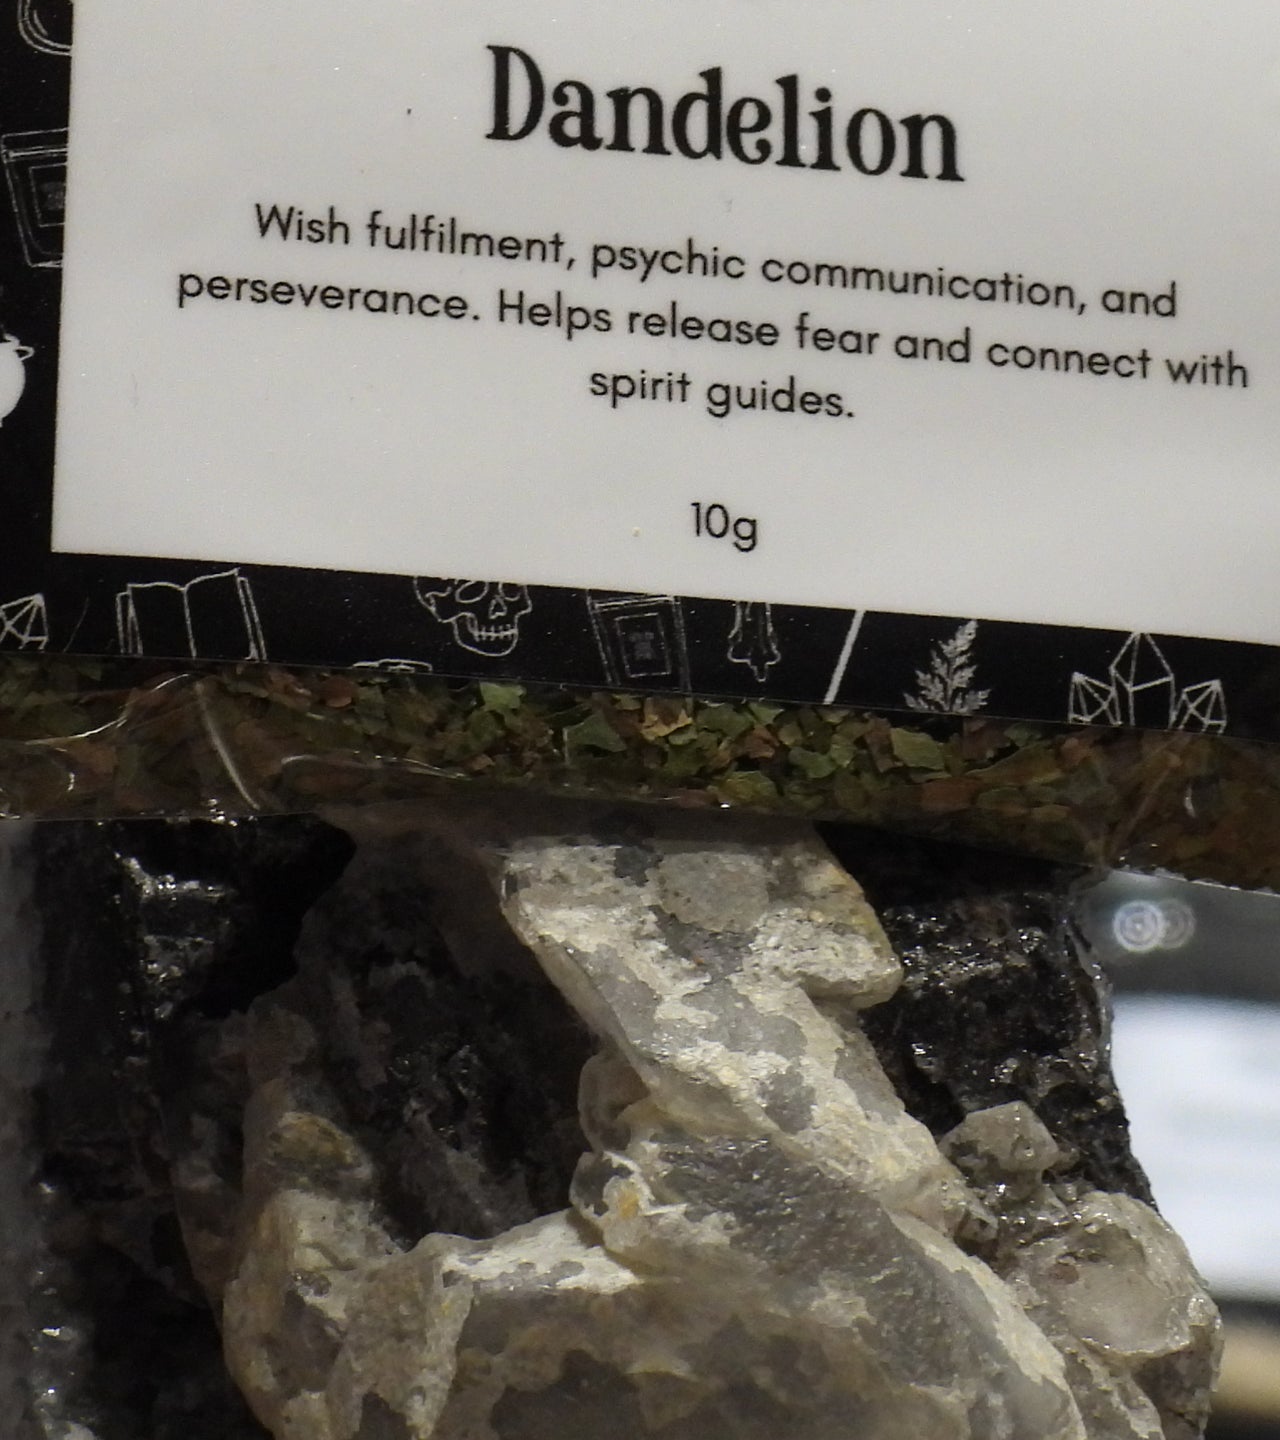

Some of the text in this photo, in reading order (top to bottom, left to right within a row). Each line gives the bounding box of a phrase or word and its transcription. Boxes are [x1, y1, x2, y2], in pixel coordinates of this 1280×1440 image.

[484, 44, 966, 182] Dandelion
[254, 203, 1177, 318] Wish fulfilment, psychic communication, and
[177, 273, 1249, 388] perseverance. Helps release fear and connect with
[589, 369, 855, 419] spirit guides.
[690, 502, 758, 553] 10g
